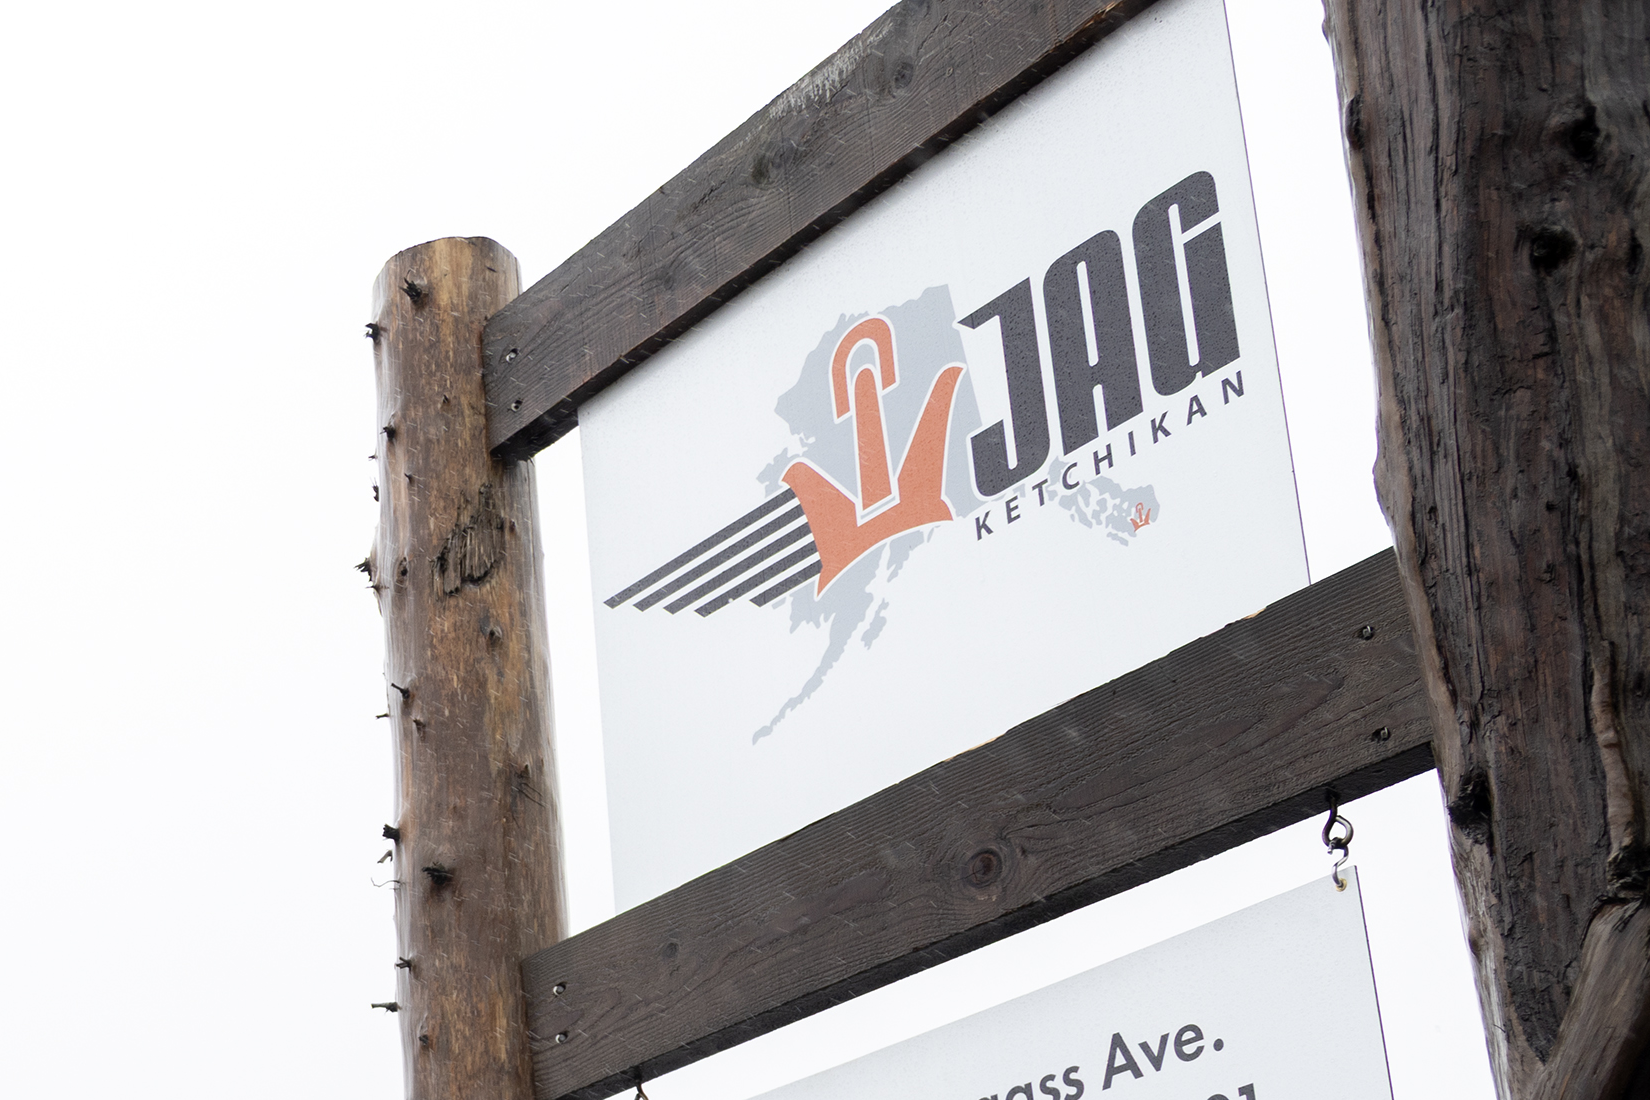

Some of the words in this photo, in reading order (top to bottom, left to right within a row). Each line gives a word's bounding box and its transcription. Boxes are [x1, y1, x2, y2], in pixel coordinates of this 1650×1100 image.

[956, 169, 1242, 498] JAG
[974, 369, 1246, 542] KETCHIKAN
[1101, 1023, 1225, 1092] Ave.
